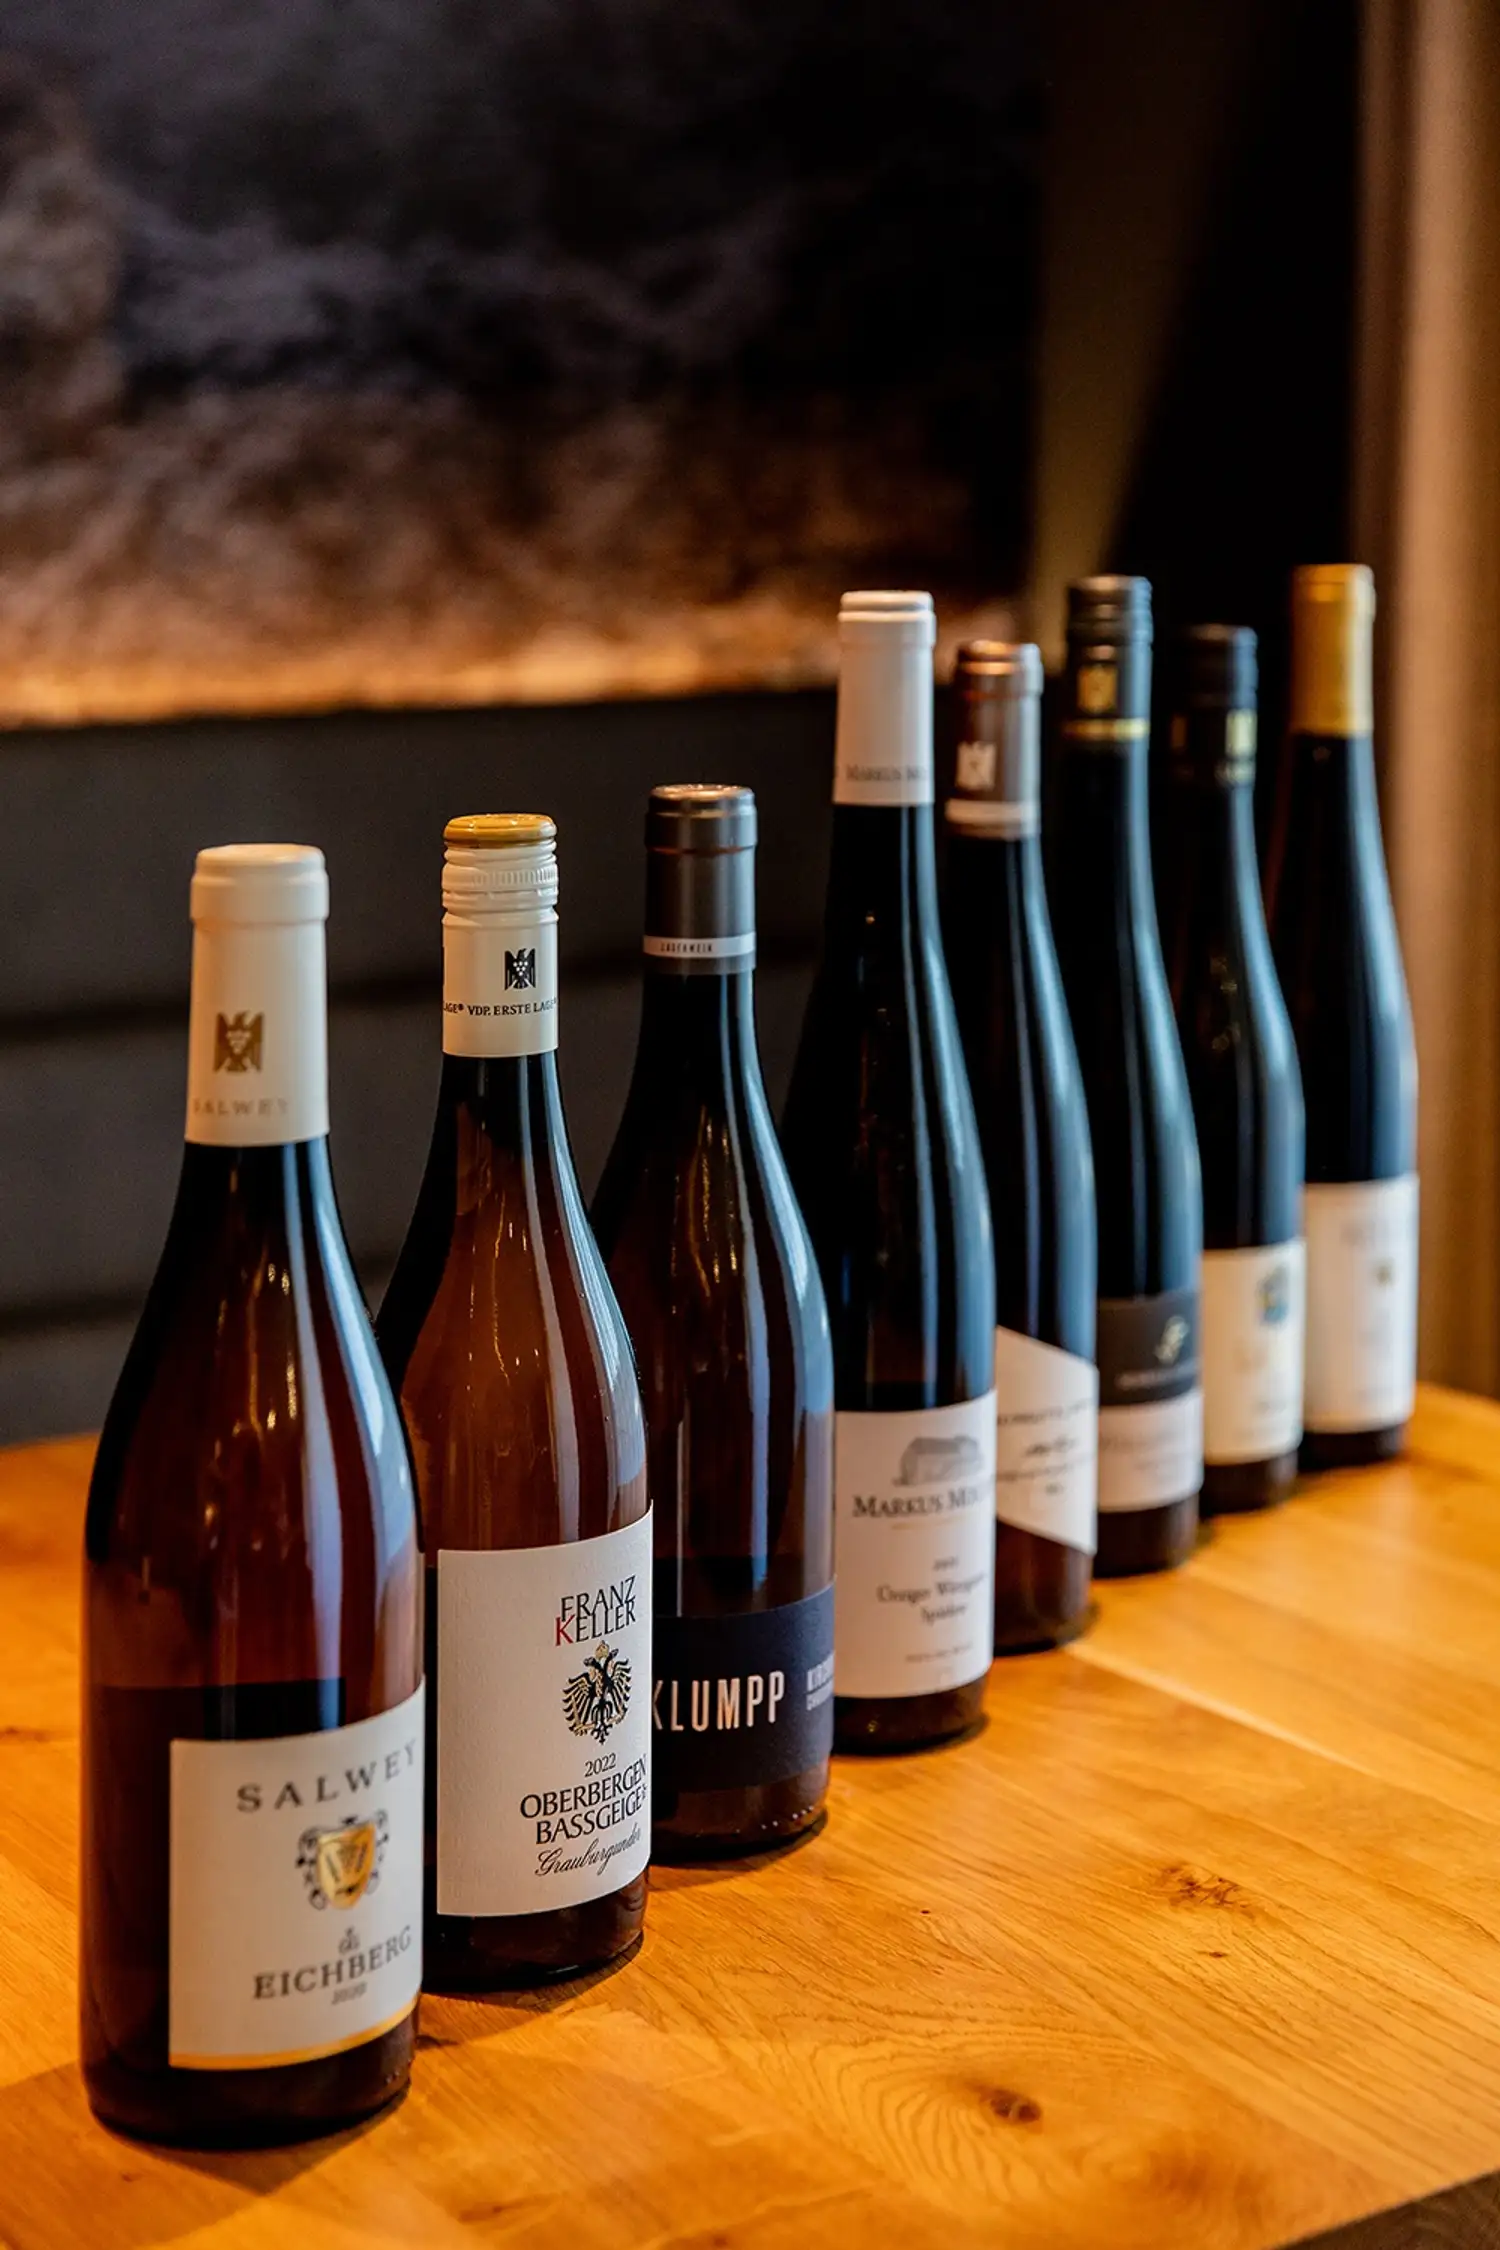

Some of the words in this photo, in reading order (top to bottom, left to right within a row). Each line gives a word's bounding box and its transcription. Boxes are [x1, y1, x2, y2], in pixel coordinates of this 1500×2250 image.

[466, 1004, 491, 1017] VDP.
[493, 1002, 532, 1016] ERSTE
[852, 1492, 943, 1518] MARKUS
[555, 1594, 636, 1646] KELLER
[560, 1574, 636, 1622] FRANZ
[652, 1670, 785, 1732] KLUMPP
[236, 1738, 417, 1813] SALWEY
[584, 1752, 617, 1777] 2022
[253, 1924, 412, 2001] EICHBERG
